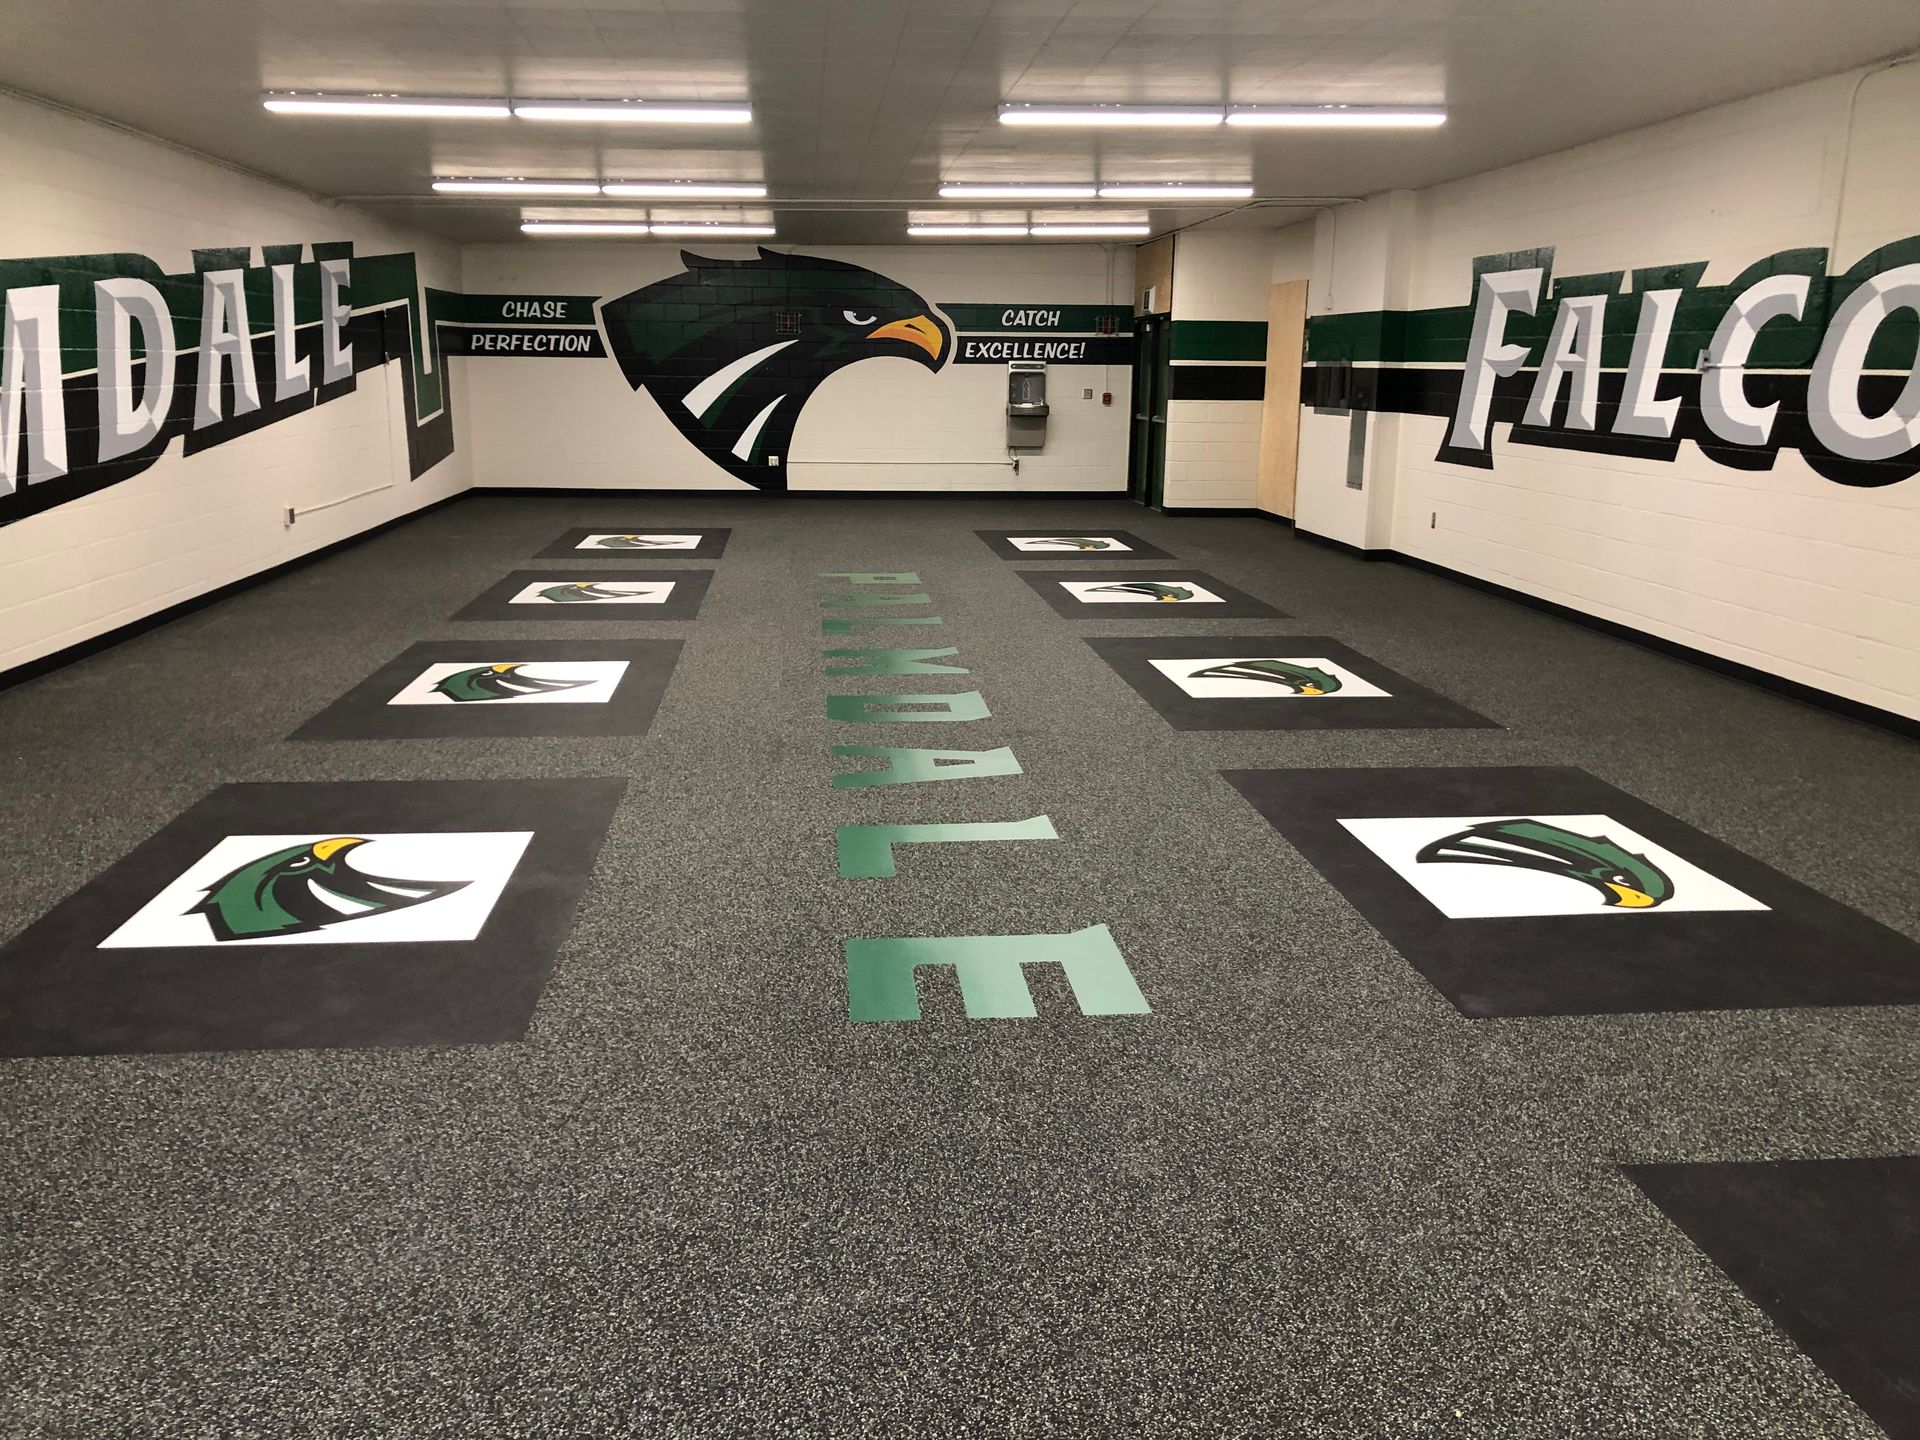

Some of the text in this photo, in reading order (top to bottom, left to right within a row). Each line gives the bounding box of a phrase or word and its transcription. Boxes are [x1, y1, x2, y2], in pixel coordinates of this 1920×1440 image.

[501, 300, 568, 319] CHASE
[1001, 309, 1061, 327] CATCH
[471, 334, 591, 352] PERFECTION
[964, 341, 1086, 359] EXCELLENCE!
[815, 571, 1152, 1022] PALMDALE
